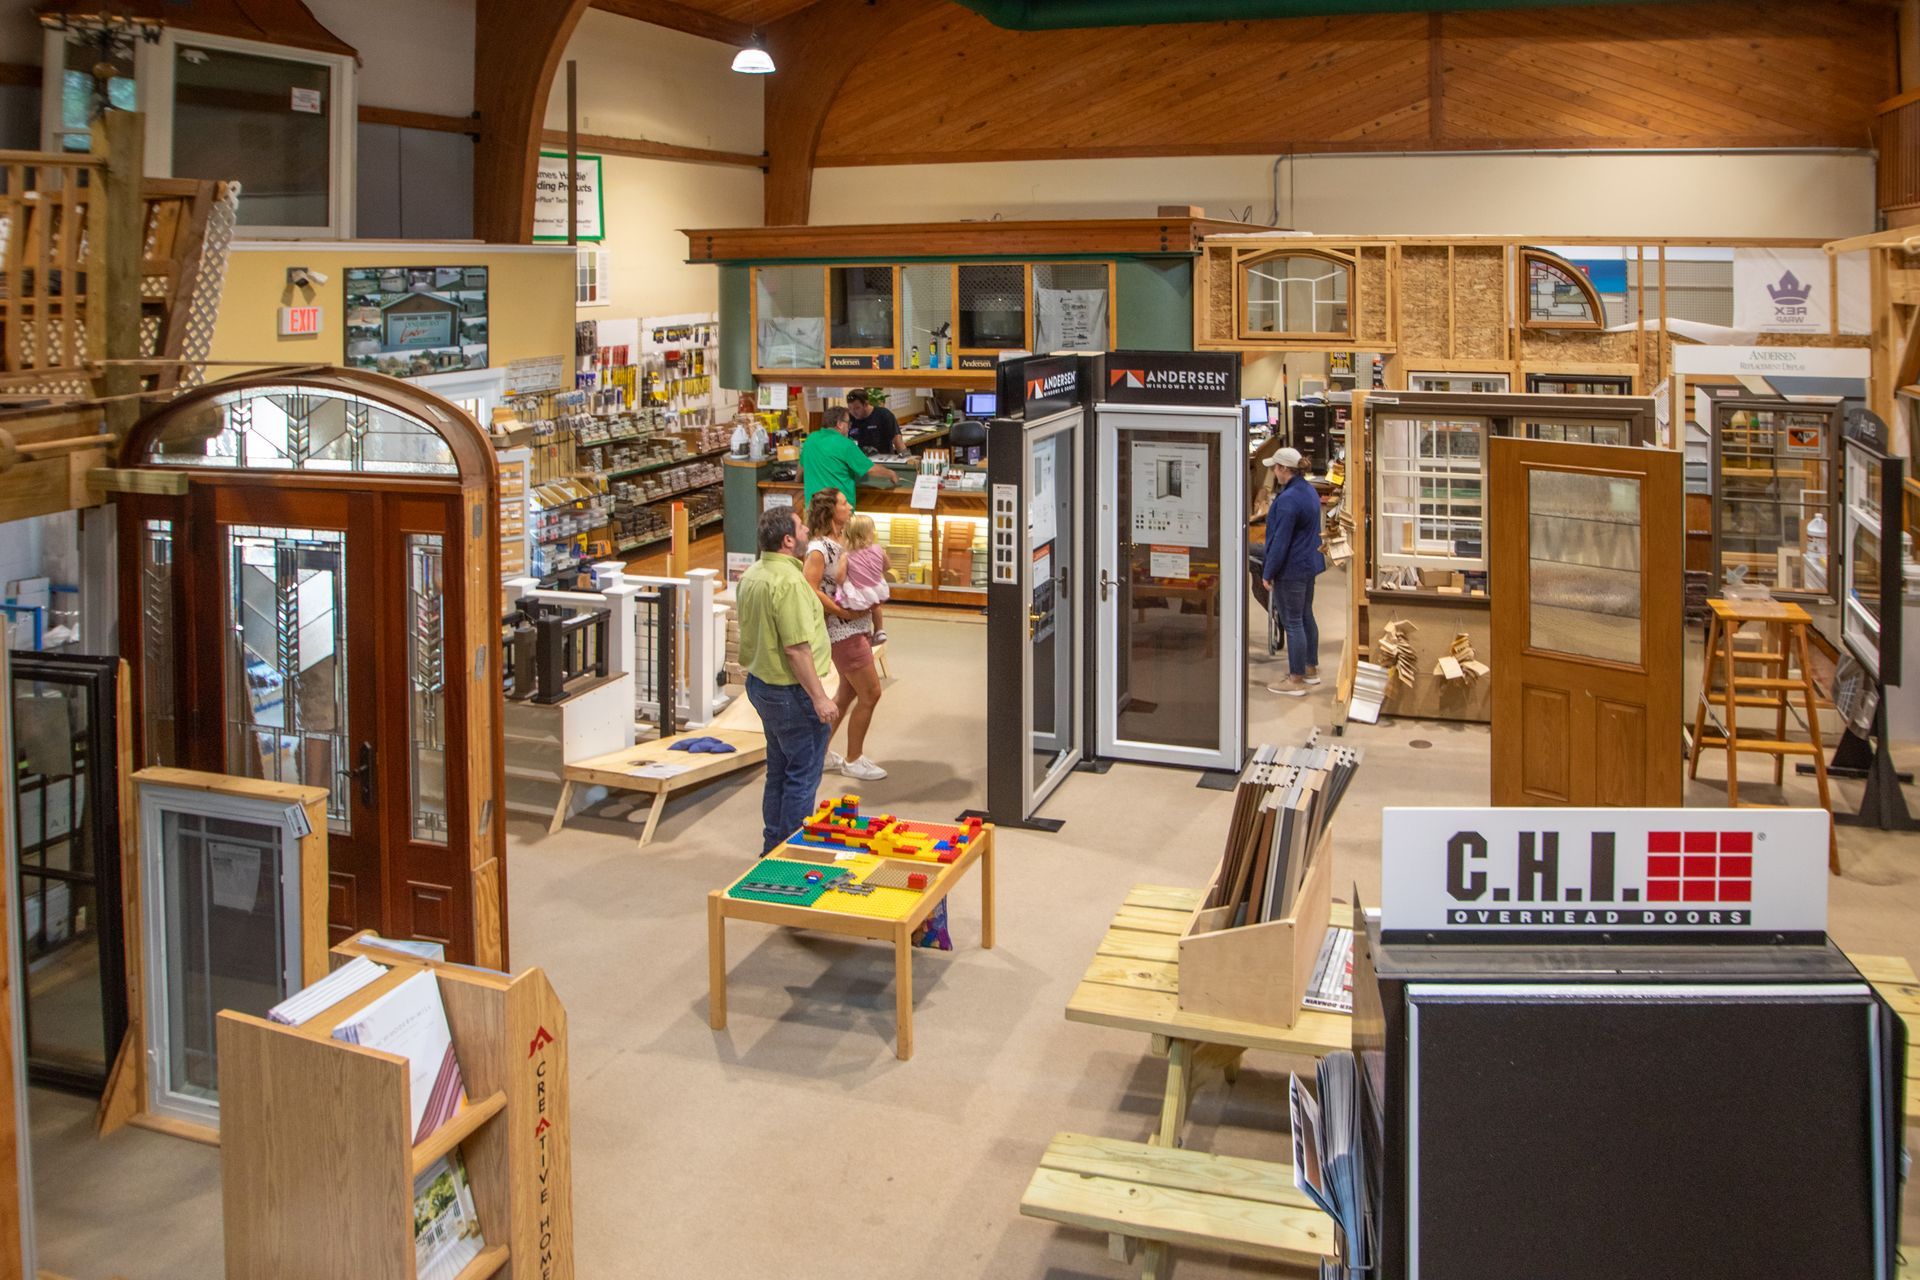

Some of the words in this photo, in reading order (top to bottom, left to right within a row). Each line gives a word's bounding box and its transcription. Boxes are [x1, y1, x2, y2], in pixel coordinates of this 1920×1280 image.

[558, 182, 592, 193] Pructs
[290, 308, 318, 332] EXIT
[832, 358, 861, 367] Andersen
[1749, 350, 1797, 361] ANDERSEN
[961, 359, 991, 368] Andersen
[1043, 370, 1076, 391] ANDERSEN
[1146, 370, 1226, 385] ANDERSEN
[1446, 831, 1640, 901] C.H.I.
[1454, 910, 1619, 924] OVERHEAD
[1643, 910, 1742, 924] DOORS
[534, 1061, 551, 1205] CREATIVE
